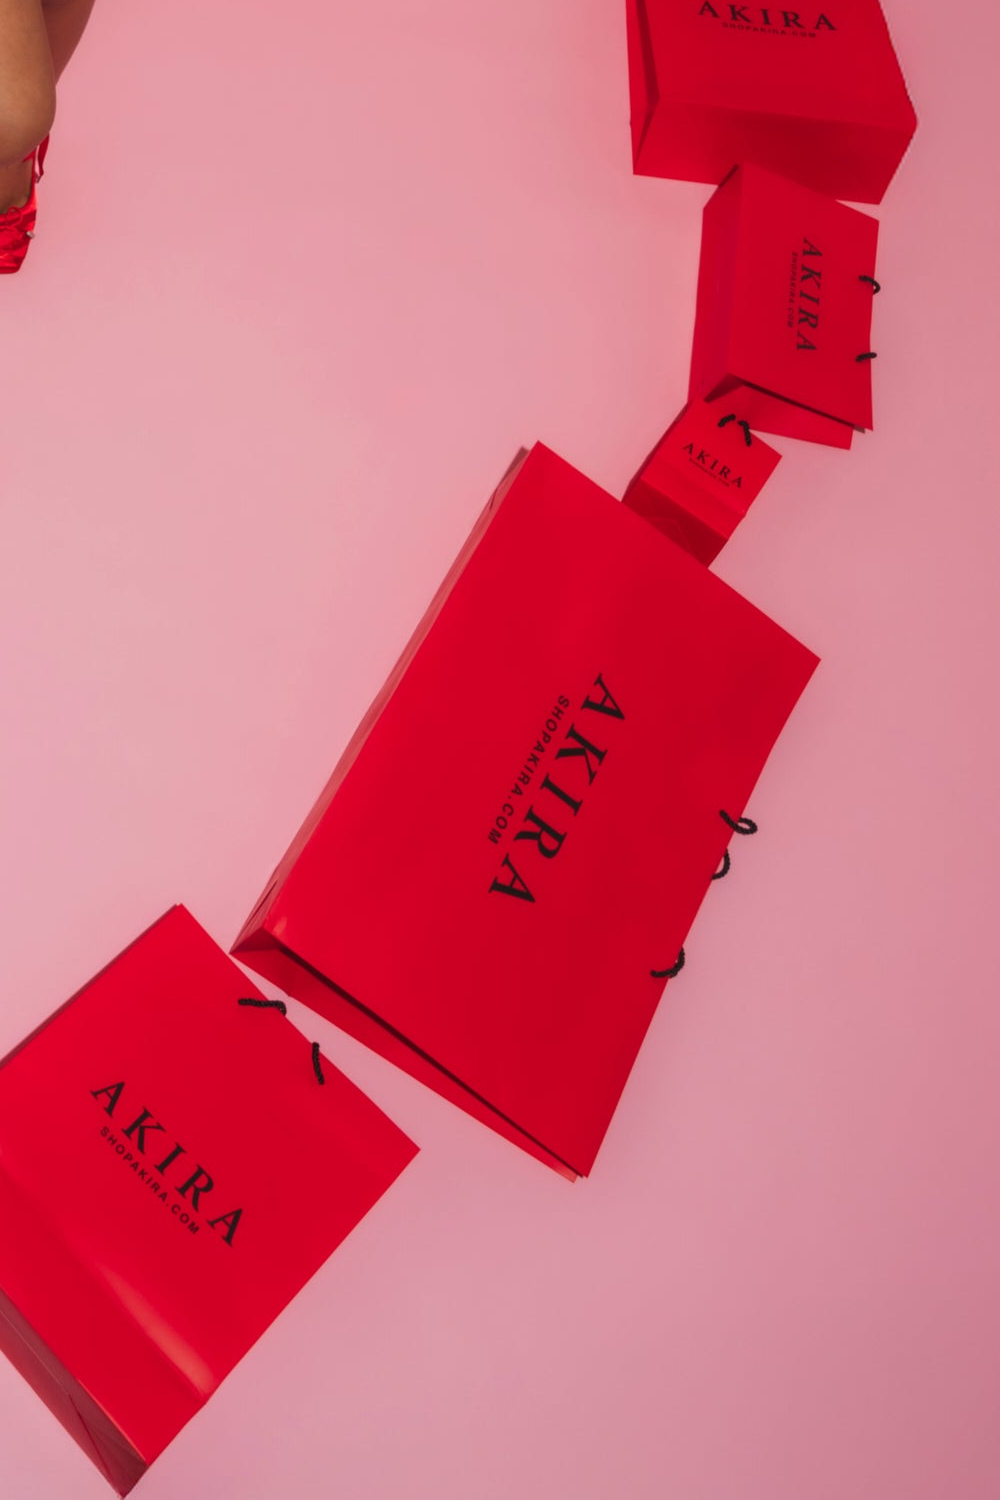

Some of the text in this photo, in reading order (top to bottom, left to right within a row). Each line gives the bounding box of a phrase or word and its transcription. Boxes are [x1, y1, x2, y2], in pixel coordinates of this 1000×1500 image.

[699, 0, 837, 31] AKIRA
[797, 238, 822, 351] AKIRA
[684, 444, 742, 488] AKIRA
[488, 695, 570, 845] SHOPAKIRA.COM
[489, 673, 626, 904] AKIRA
[91, 1081, 243, 1246] AKIRA
[99, 1126, 201, 1235] SHOPAKIRA.COM
